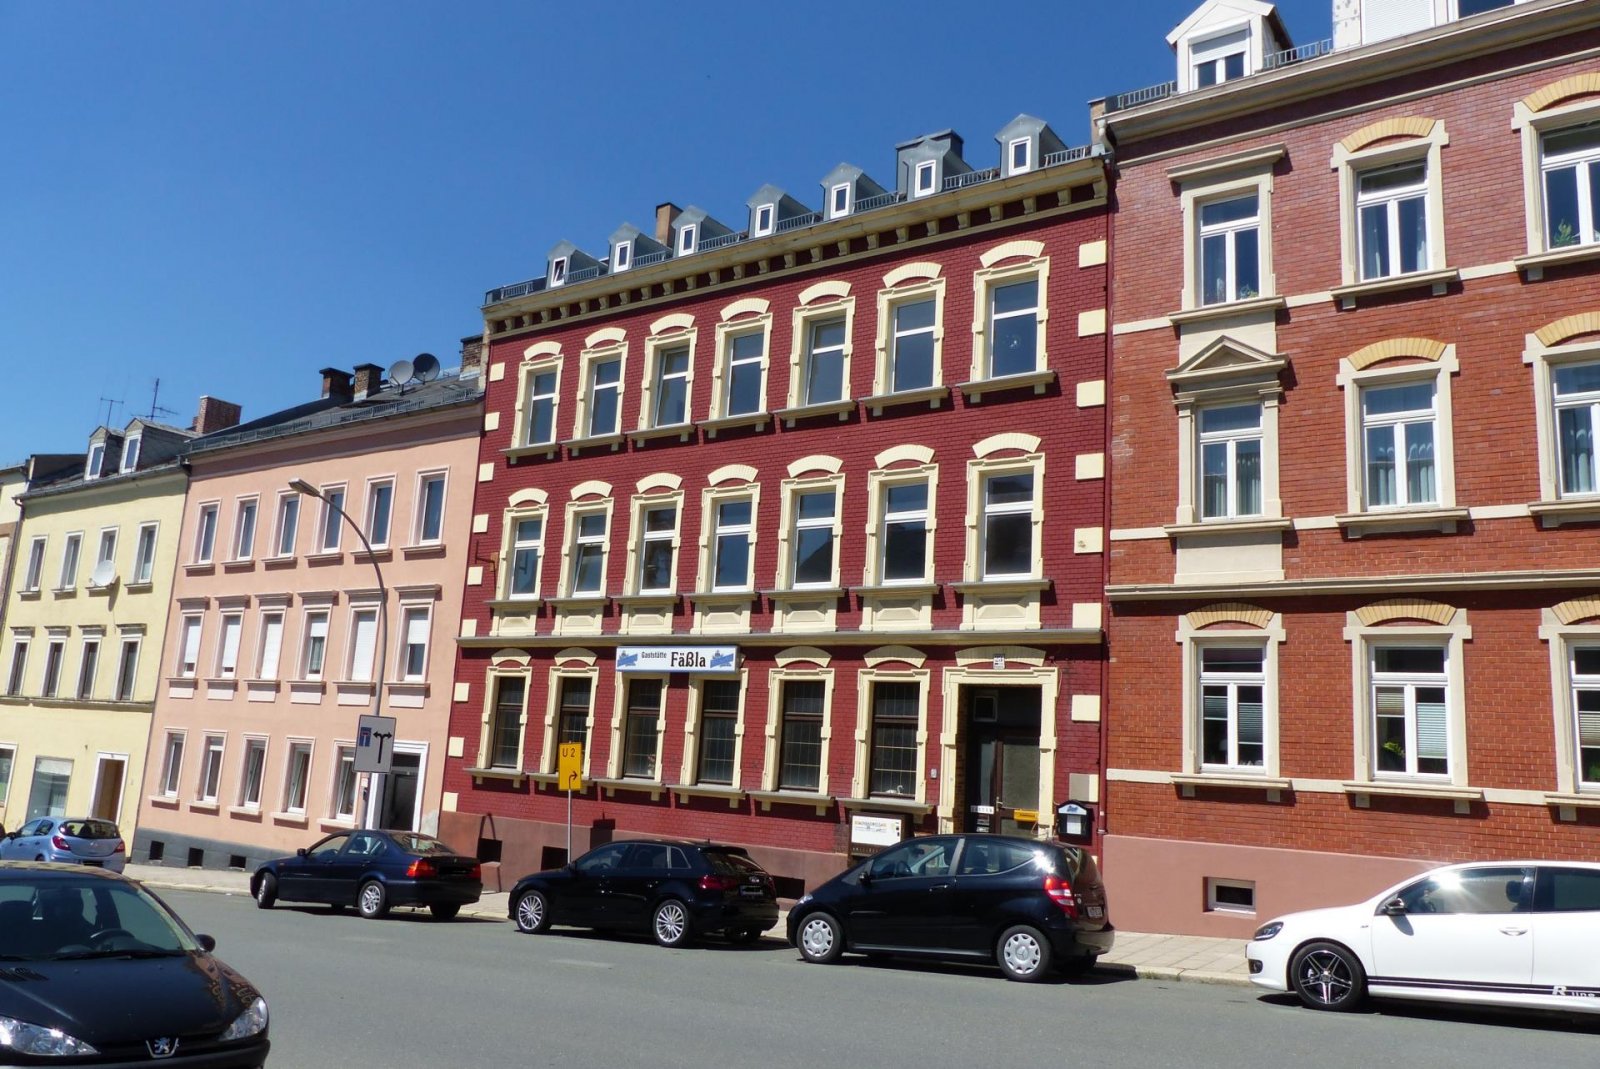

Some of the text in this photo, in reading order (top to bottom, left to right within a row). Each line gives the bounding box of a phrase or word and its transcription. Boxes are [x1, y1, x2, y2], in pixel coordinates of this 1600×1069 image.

[641, 651, 706, 667] Gaststätte Fäßla
[1552, 985, 1567, 996] R
